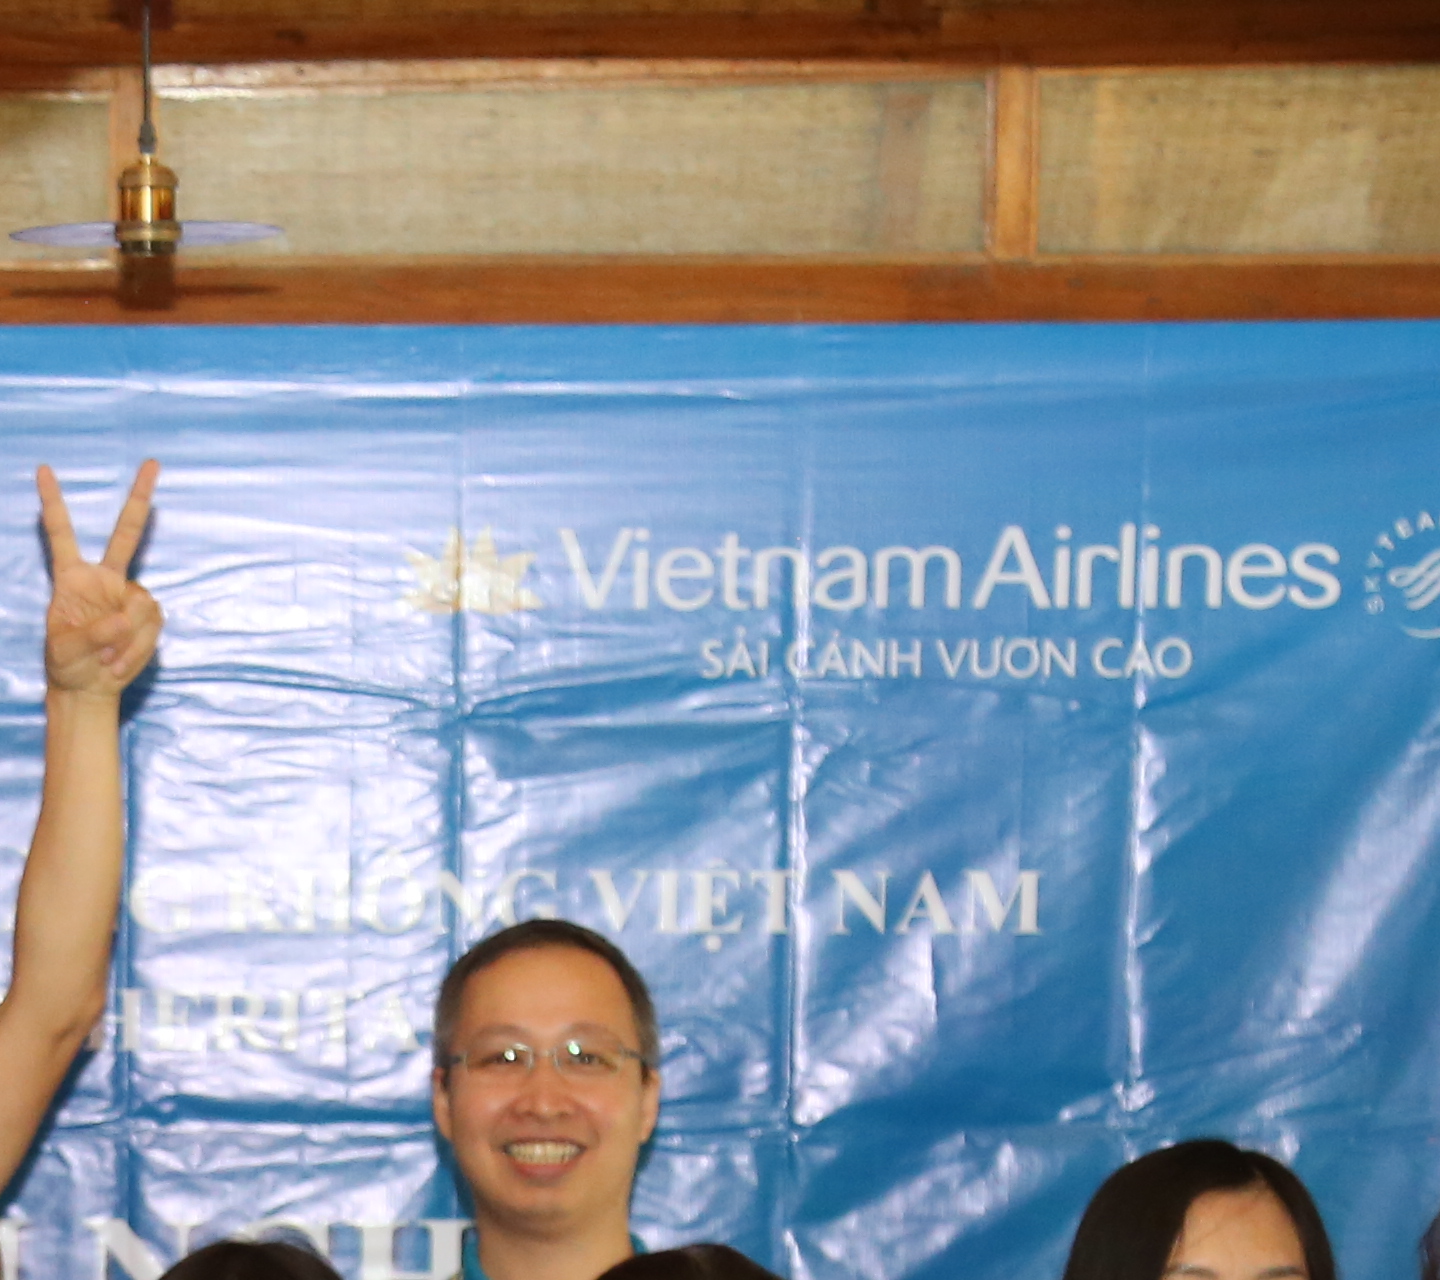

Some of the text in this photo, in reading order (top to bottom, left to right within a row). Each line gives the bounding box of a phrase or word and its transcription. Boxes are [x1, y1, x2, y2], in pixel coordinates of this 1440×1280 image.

[558, 522, 1342, 612] Vietnam Airlines
[1091, 636, 1193, 679] CAO
[589, 858, 804, 952] VIỆT
[831, 869, 1042, 936] NAM
